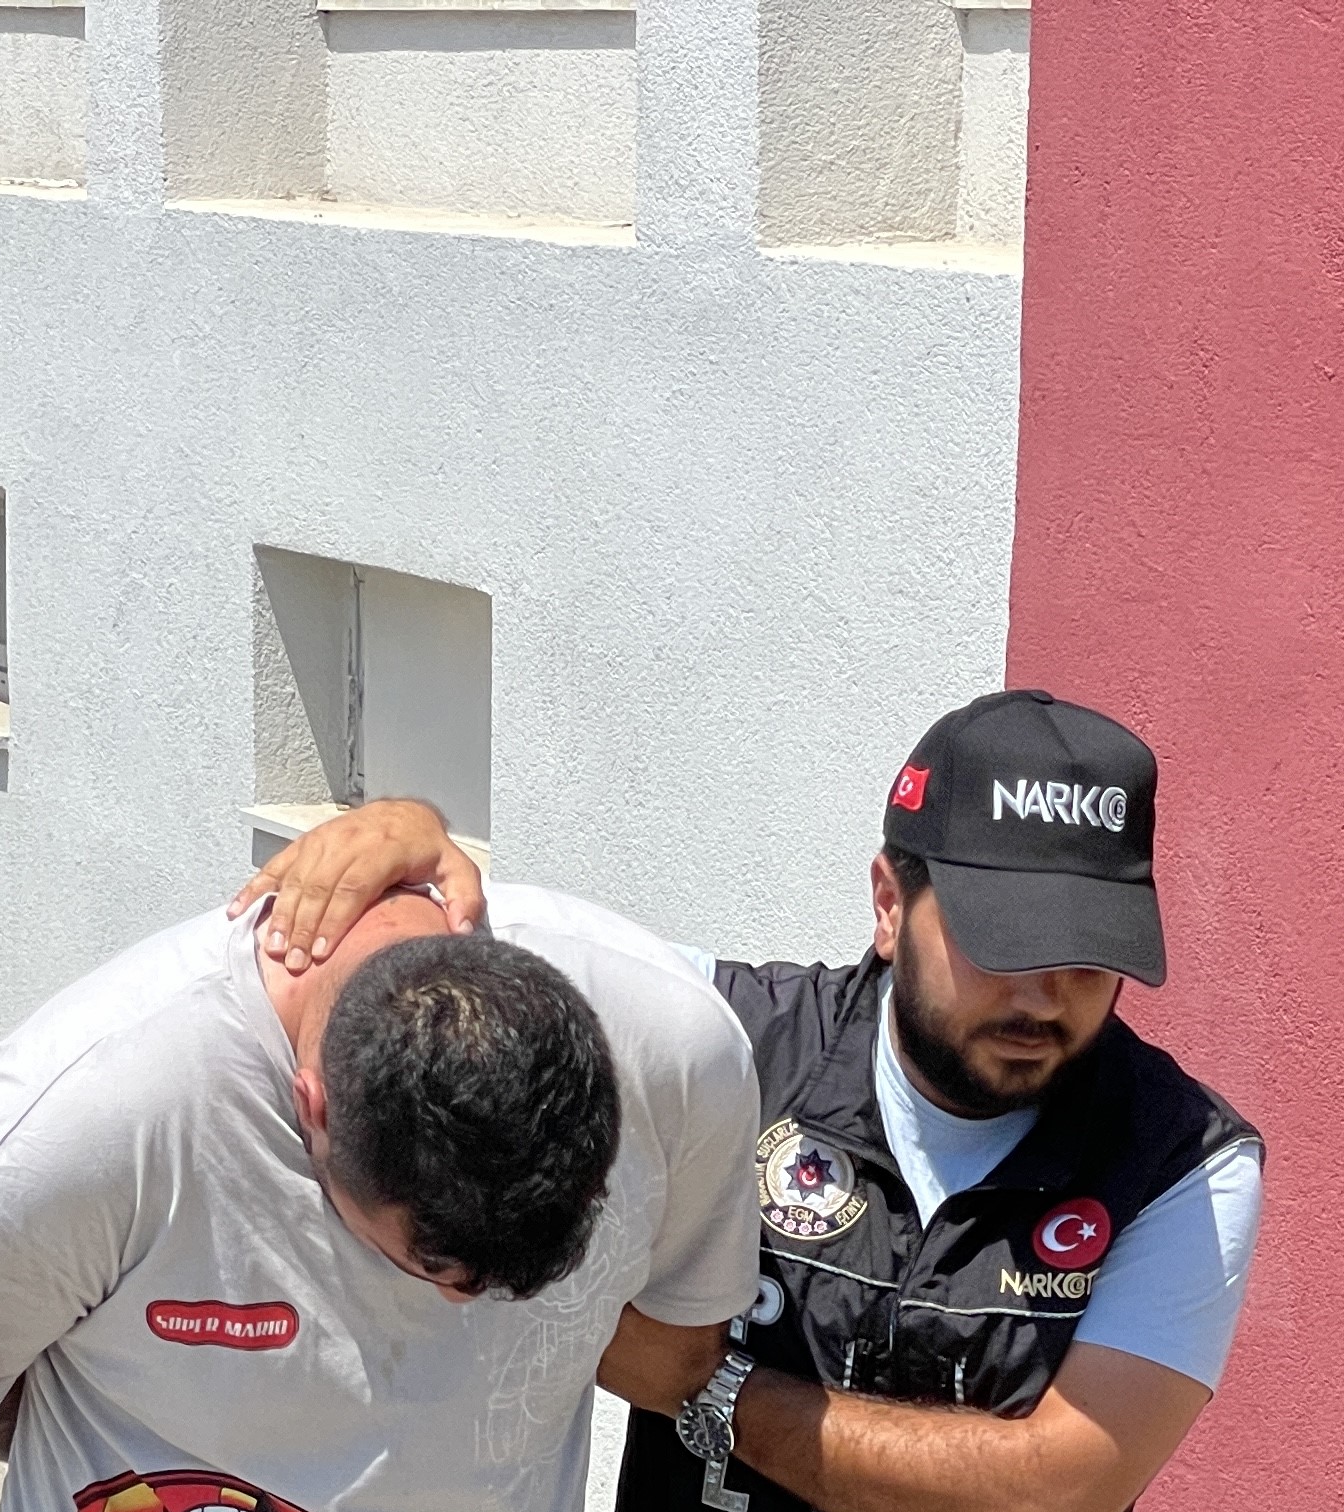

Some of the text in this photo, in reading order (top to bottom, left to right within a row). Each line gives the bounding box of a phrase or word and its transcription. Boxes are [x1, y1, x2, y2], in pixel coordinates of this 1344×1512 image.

[787, 1207, 814, 1223] EGM
[1000, 1268, 1100, 1299] NARKOT
[156, 1315, 288, 1338] SUPER MARIO
